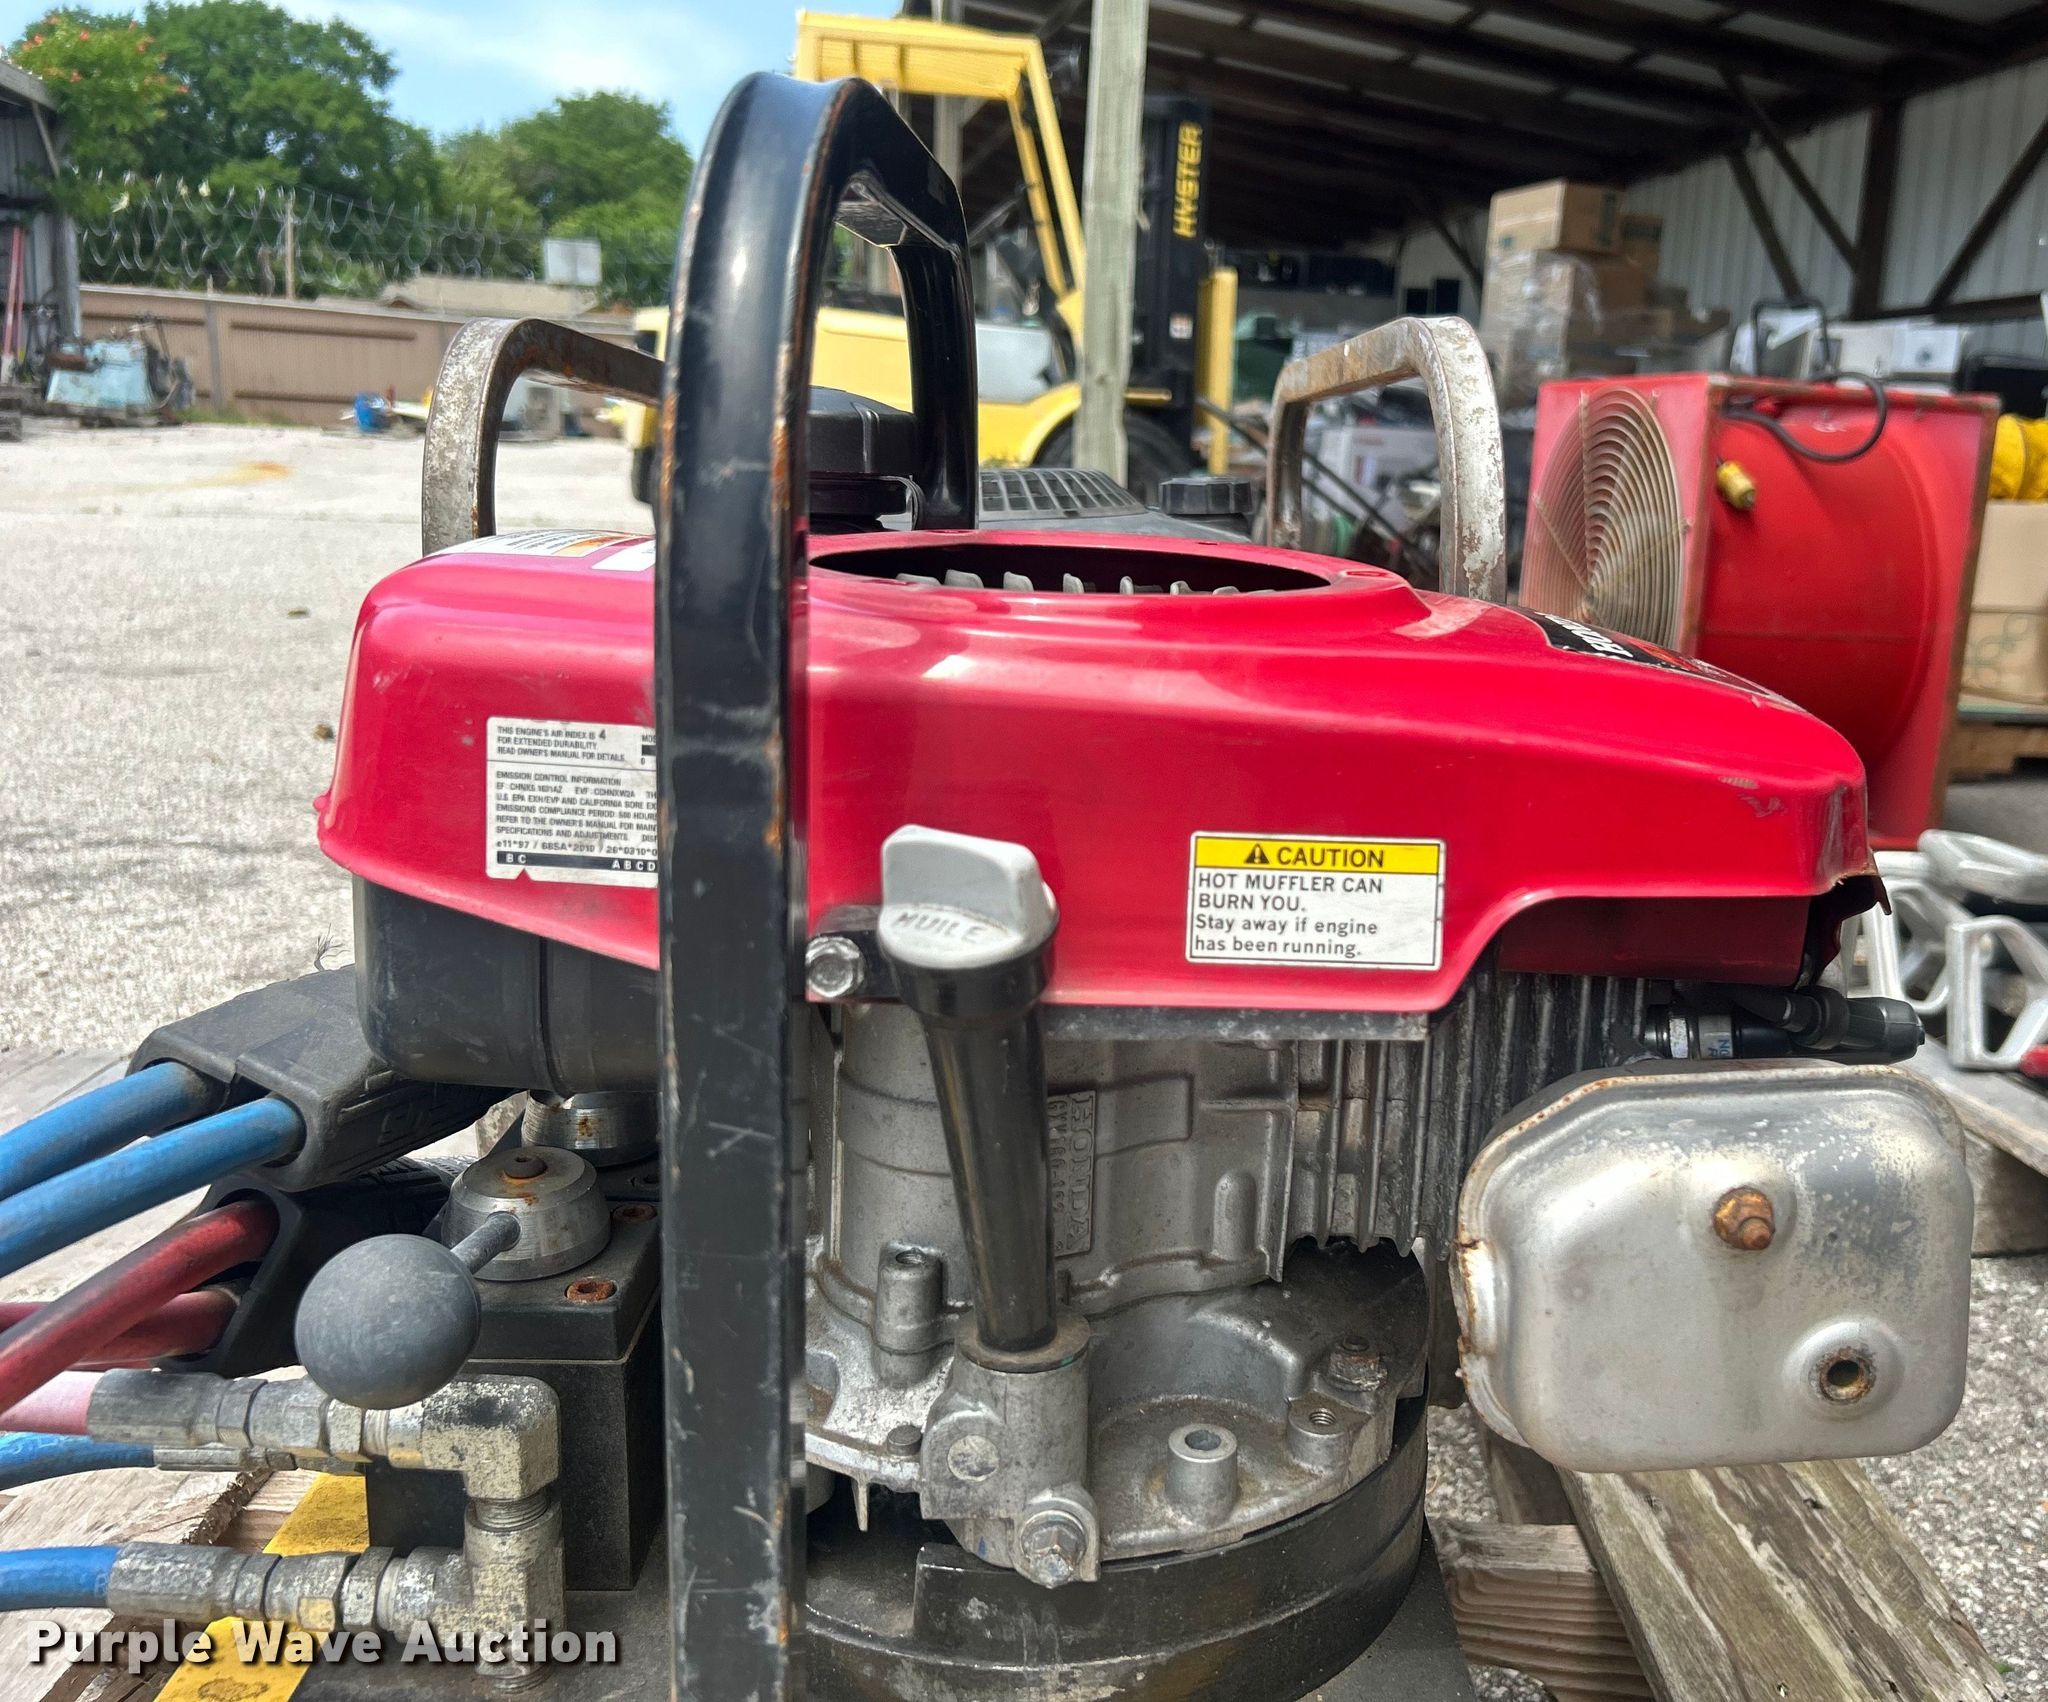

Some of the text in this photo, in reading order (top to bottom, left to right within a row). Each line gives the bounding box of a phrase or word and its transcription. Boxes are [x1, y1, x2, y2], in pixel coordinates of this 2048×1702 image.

[1173, 120, 1203, 238] HYSTER
[497, 726, 513, 735] THIS
[551, 729, 563, 737] AIR
[565, 731, 587, 739] INDEX
[589, 732, 596, 740] IS
[599, 729, 606, 741] 4
[497, 736, 512, 745] FOR
[514, 737, 552, 748] EXTENDED
[497, 746, 515, 755] READ
[518, 747, 548, 757] OWNER'S
[550, 749, 580, 760] MANUAL
[582, 751, 595, 760] FOR
[496, 770, 621, 787] EMISSION CONTROL INFORMATION
[512, 794, 525, 802] EPA
[561, 796, 577, 805] AND
[579, 797, 622, 808] CALIFORNIA
[496, 804, 537, 814] EMISSIONS
[539, 806, 586, 817] COMPLIANCE
[496, 815, 518, 824] REFER
[520, 816, 532, 825] TO
[533, 816, 547, 826] THE
[549, 818, 584, 828] OWNER'S
[585, 820, 617, 830] MANUAL
[620, 822, 633, 831] FOR
[496, 826, 553, 837] SPECIFICATIONS
[556, 829, 572, 838] AND
[505, 853, 656, 872] B C A B C D
[1277, 846, 1385, 868] CAUTION
[1198, 872, 1383, 894] HOT MUFFLER CAN
[1198, 893, 1307, 912] BURN YOU.
[1195, 913, 1378, 938] Stay away if engine
[1194, 935, 1362, 959] has been running.
[1067, 1095, 1094, 1250] HONDA
